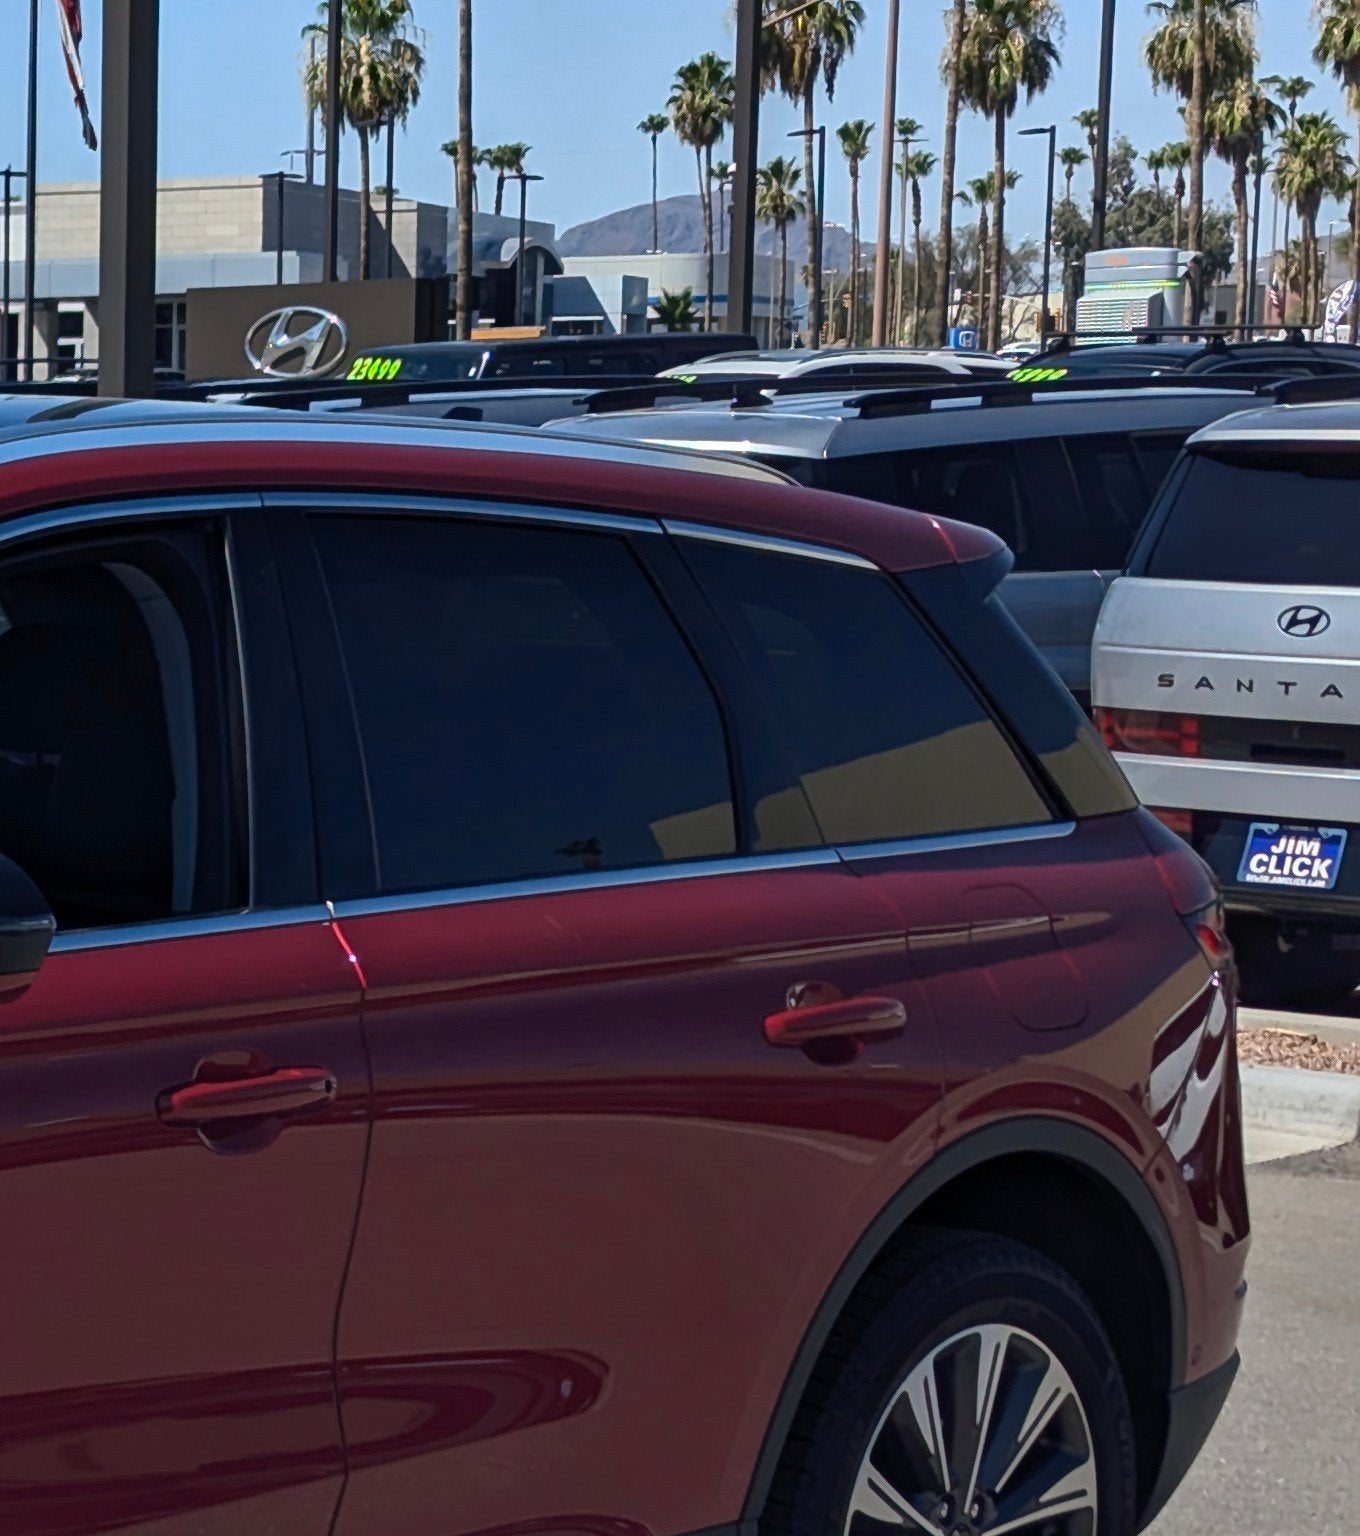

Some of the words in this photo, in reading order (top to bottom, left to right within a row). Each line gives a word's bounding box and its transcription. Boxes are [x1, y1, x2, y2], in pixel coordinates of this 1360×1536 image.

[1157, 673, 1343, 699] SANTA
[1270, 835, 1321, 857] JIM
[1249, 853, 1333, 879] CLICK
